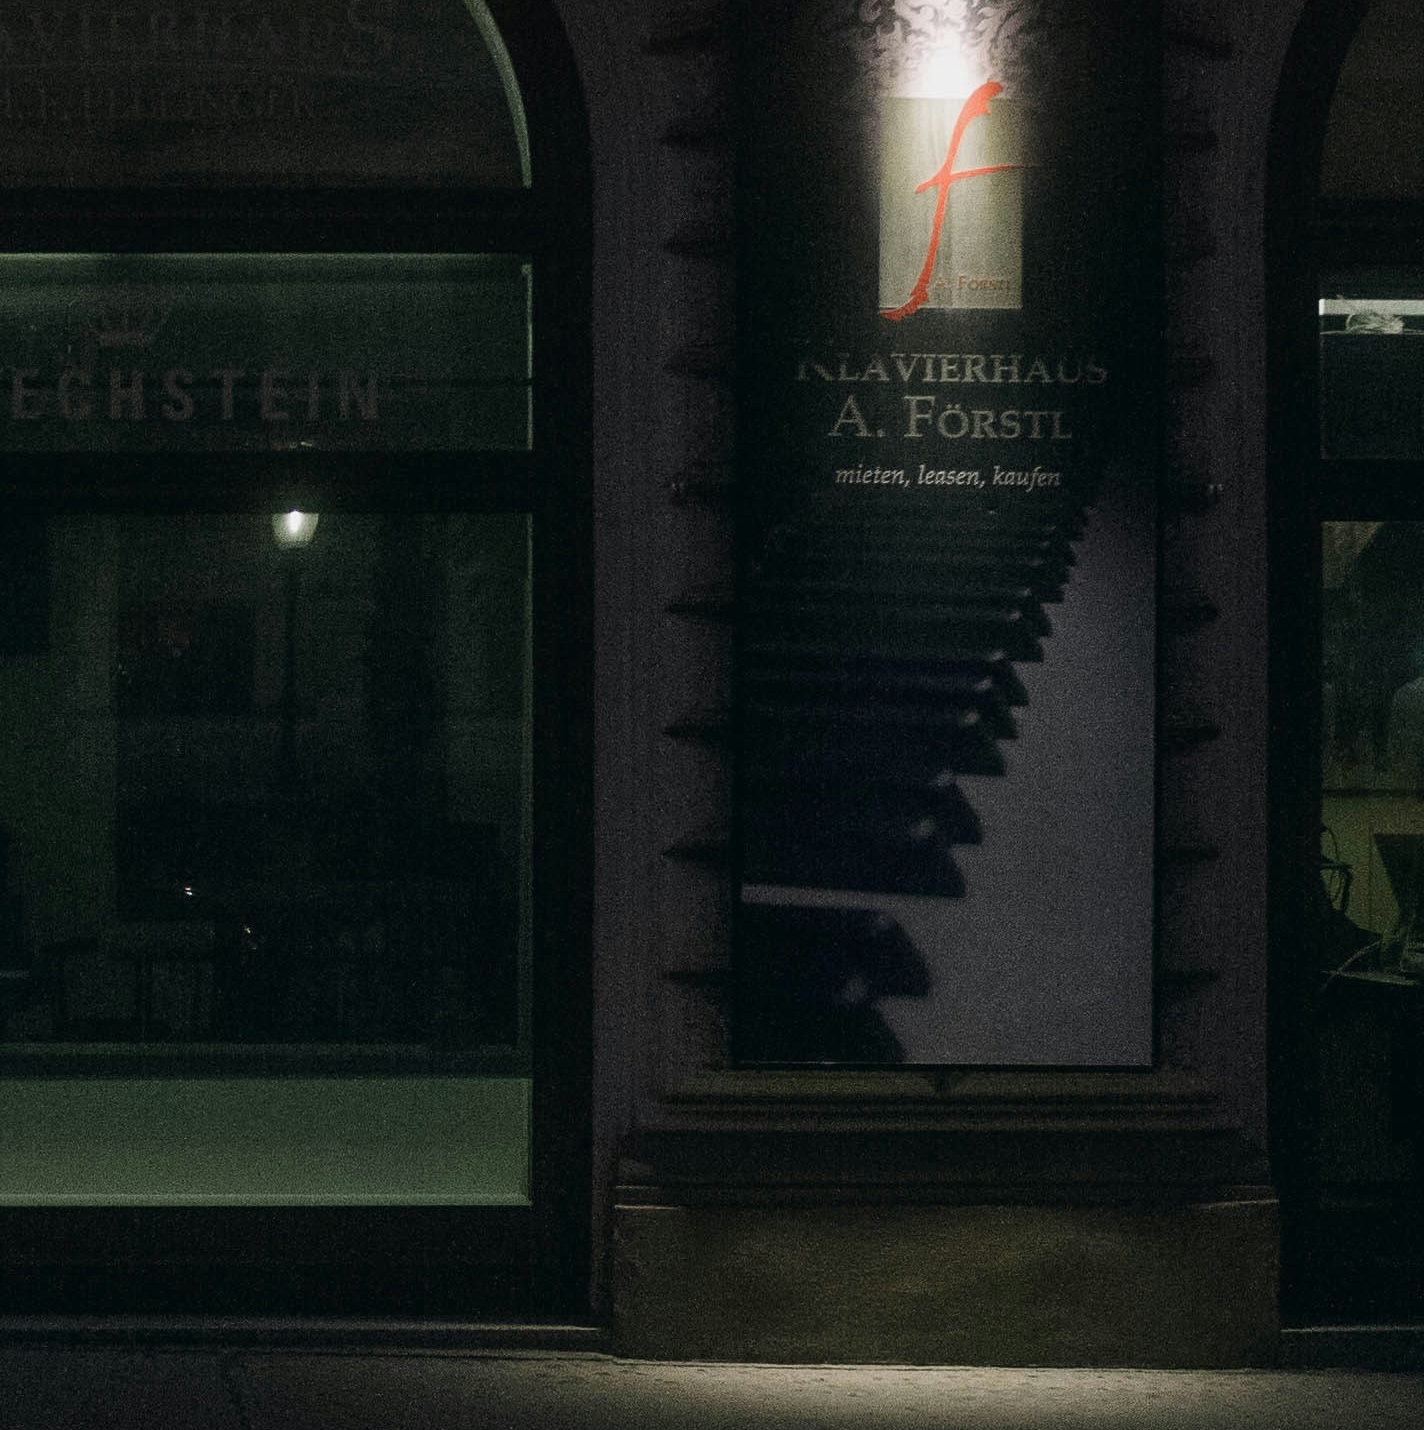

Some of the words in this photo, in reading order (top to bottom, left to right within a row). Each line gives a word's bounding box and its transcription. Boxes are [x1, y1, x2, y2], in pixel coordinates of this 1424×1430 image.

[796, 351, 1108, 385] KLAVIERHAUS
[827, 394, 887, 439] A.
[903, 394, 1073, 440] FÖRSTL
[834, 465, 912, 488] mieten,
[917, 464, 986, 489] leasen,
[991, 465, 1062, 493] kaufen
